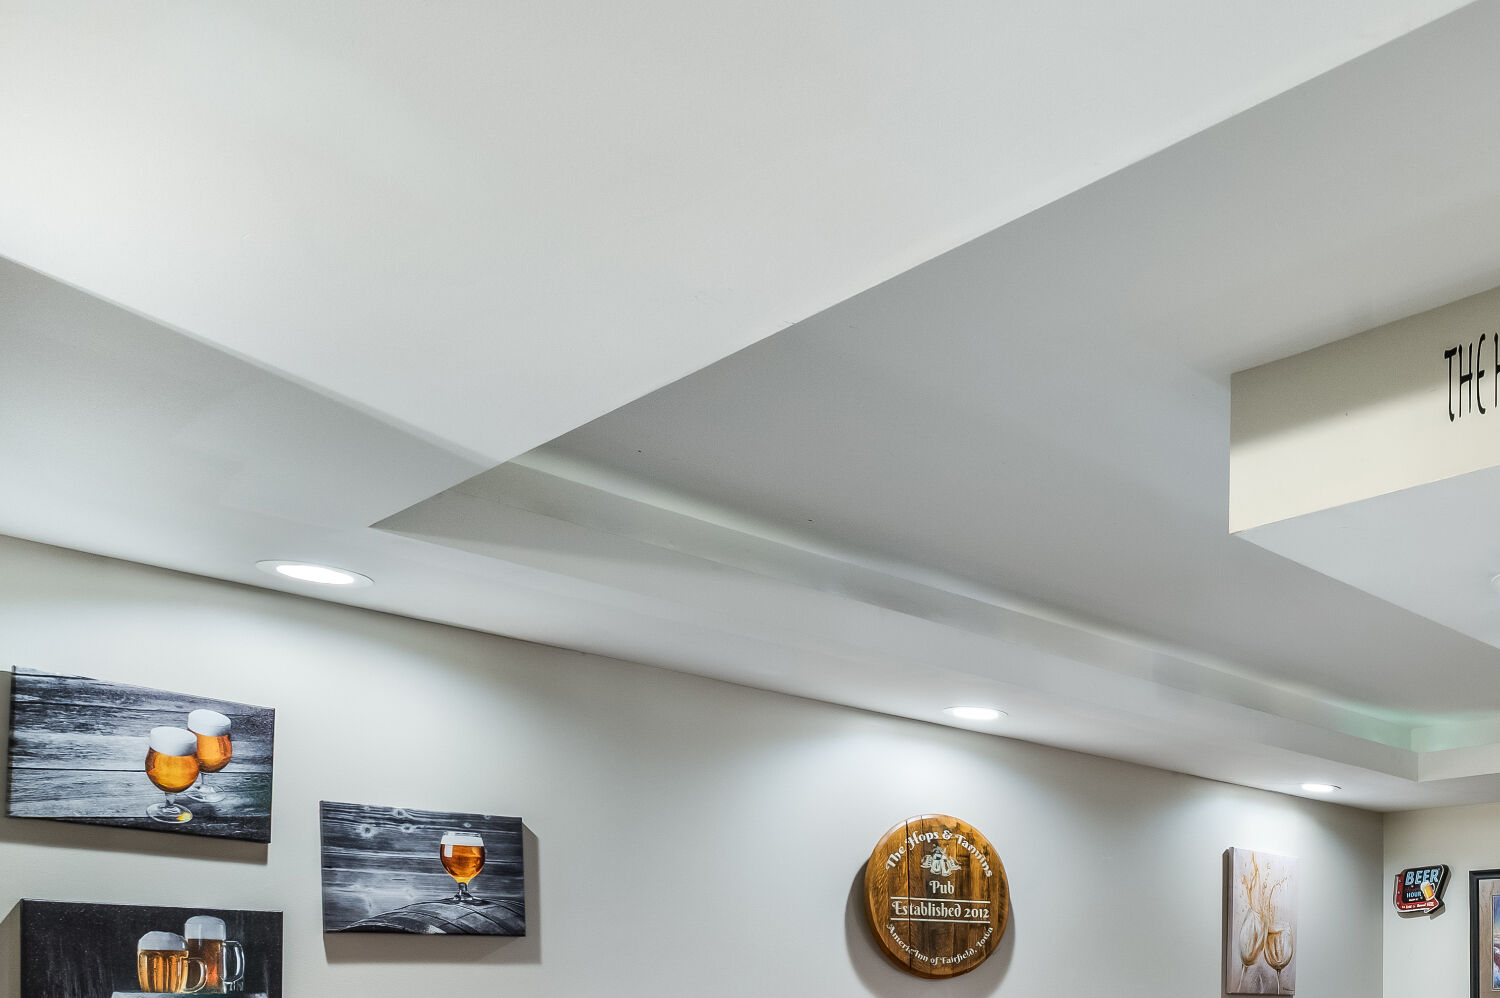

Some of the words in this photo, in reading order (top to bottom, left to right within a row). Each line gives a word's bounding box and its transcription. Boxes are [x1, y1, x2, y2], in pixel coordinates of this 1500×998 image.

[1444, 333, 1486, 422] THE
[885, 845, 906, 870] The
[904, 830, 939, 851] Hops
[941, 830, 952, 840] &
[955, 834, 993, 878] Tannins
[1405, 869, 1439, 885] BEER
[929, 880, 955, 894] Pub
[892, 901, 961, 918] Established
[964, 908, 990, 919] 2012
[976, 926, 993, 947] Iowa
